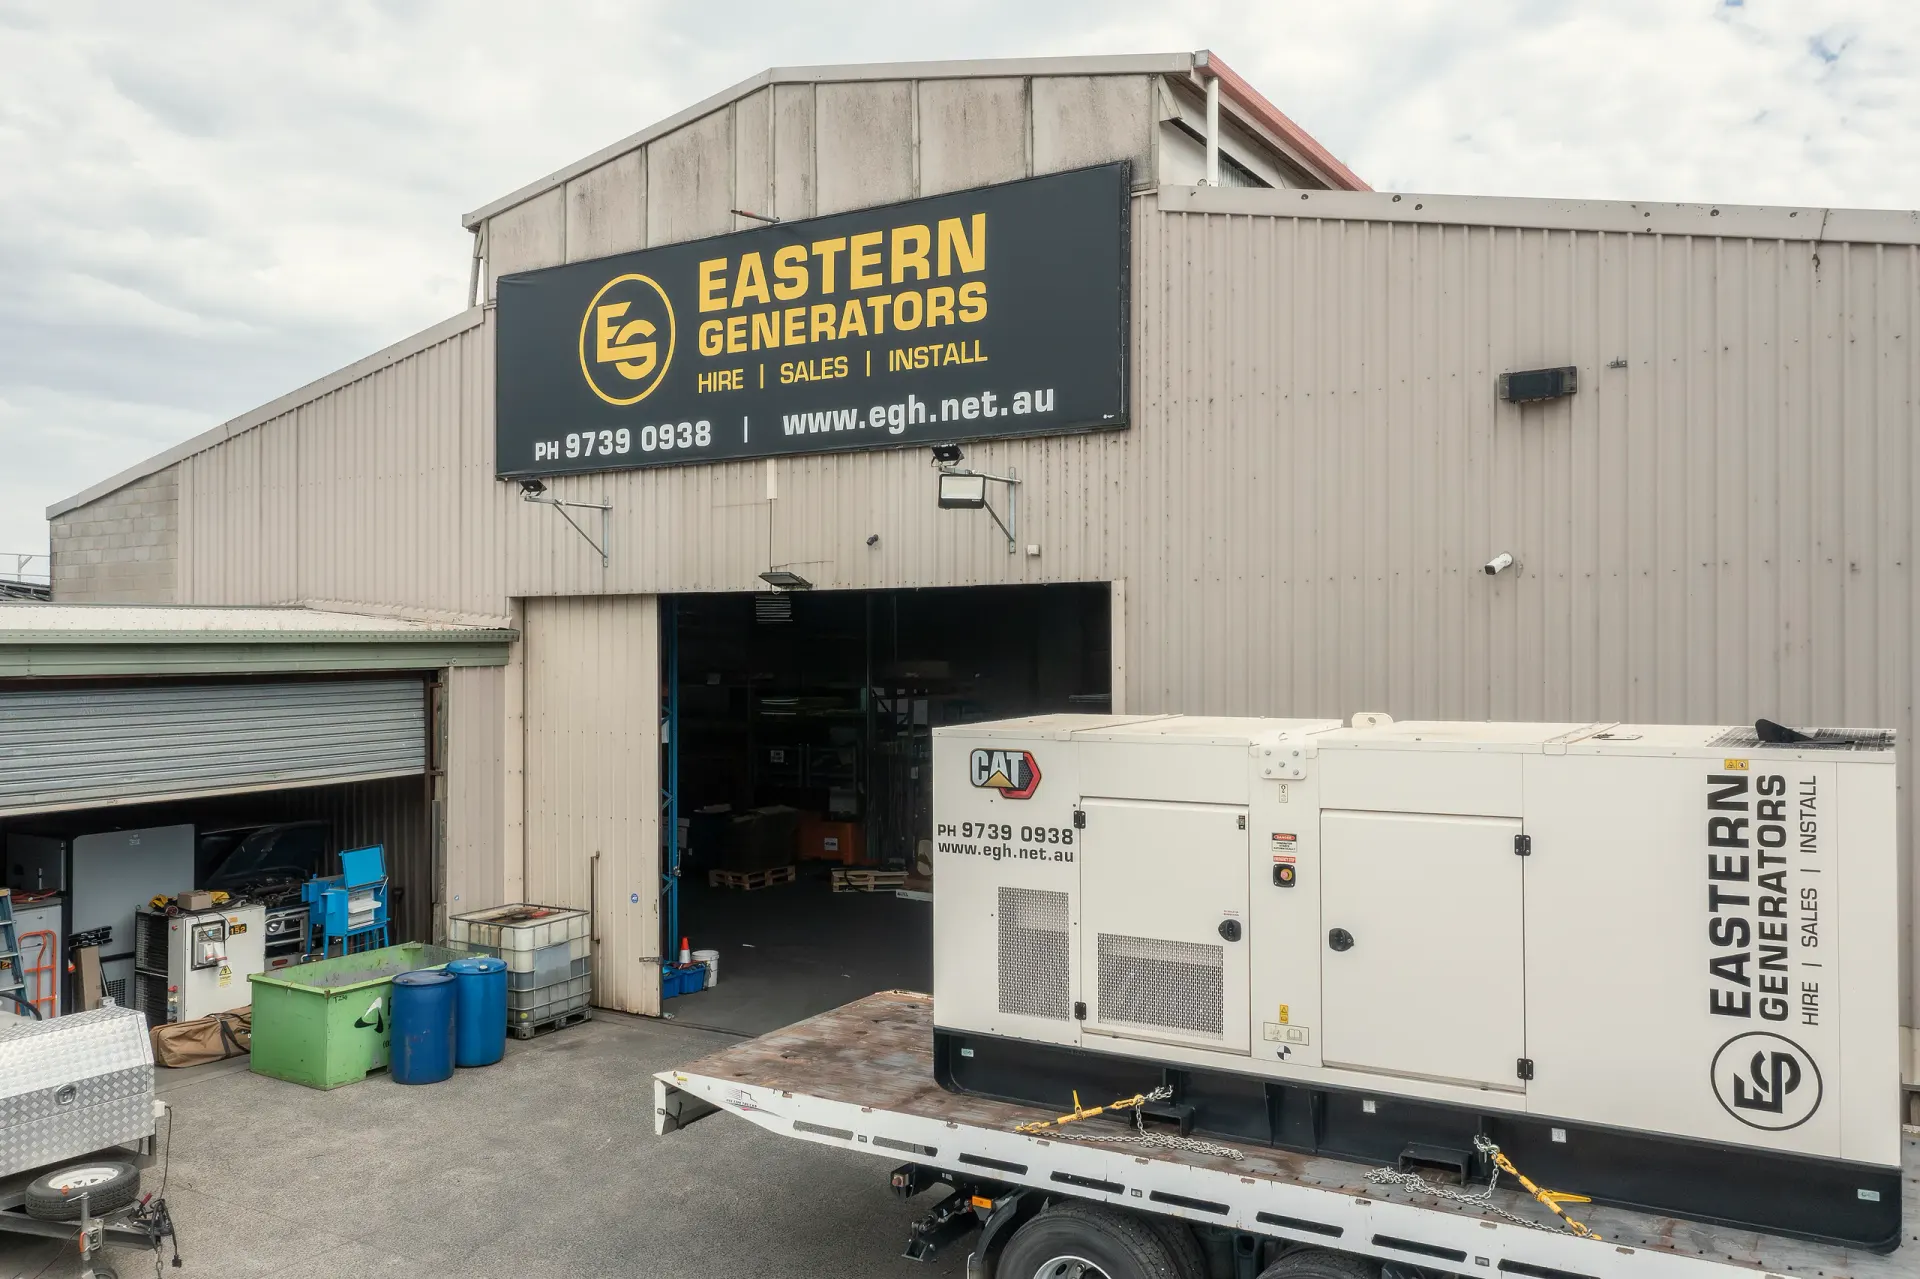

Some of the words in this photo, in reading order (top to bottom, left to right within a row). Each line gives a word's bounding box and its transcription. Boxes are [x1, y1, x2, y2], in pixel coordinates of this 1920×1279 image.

[698, 212, 986, 313] EASTERN
[698, 281, 988, 357] GENERATORS
[698, 368, 744, 393] HIRE
[780, 355, 849, 384] SALES
[889, 339, 989, 372] INSTALL
[535, 440, 560, 462] PH
[565, 427, 631, 459] 9739
[641, 419, 712, 452] 0938
[782, 388, 1055, 436] www.egh.net.au
[971, 750, 1024, 788] CAT
[937, 823, 957, 837] PH
[961, 821, 1012, 841] 9739
[1020, 825, 1074, 846] 0938
[1799, 775, 1817, 854] INSTALL
[937, 842, 1074, 863] www.egh.net.au
[1706, 774, 1752, 1019] EASTERN
[1756, 774, 1789, 1022] GENERATORS
[1800, 888, 1819, 948] SALES
[1801, 981, 1819, 1026] HIRE
